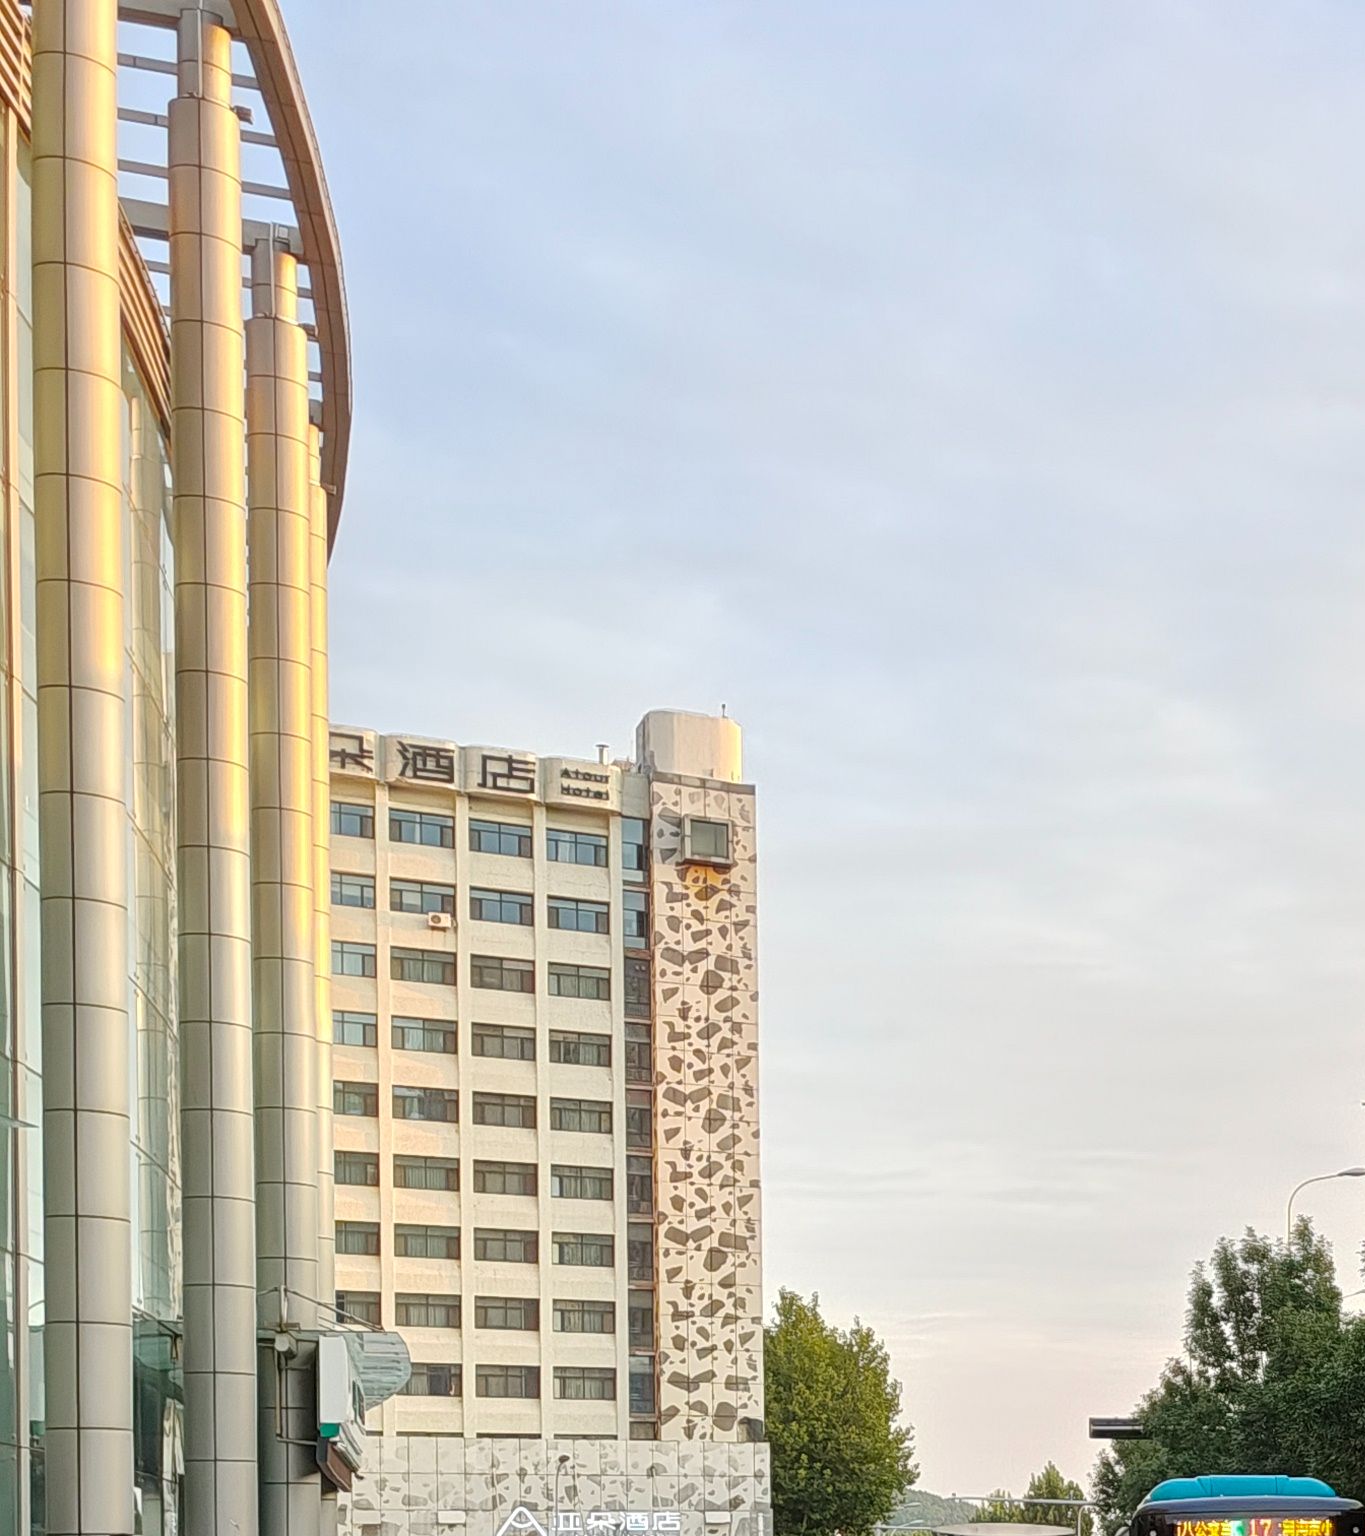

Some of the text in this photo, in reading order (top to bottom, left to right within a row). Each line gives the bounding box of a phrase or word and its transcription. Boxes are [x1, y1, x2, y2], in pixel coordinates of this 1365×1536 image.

[560, 767, 610, 784] Atour
[560, 783, 610, 801] Hotel
[551, 1511, 682, 1532] 亚朵酒店
